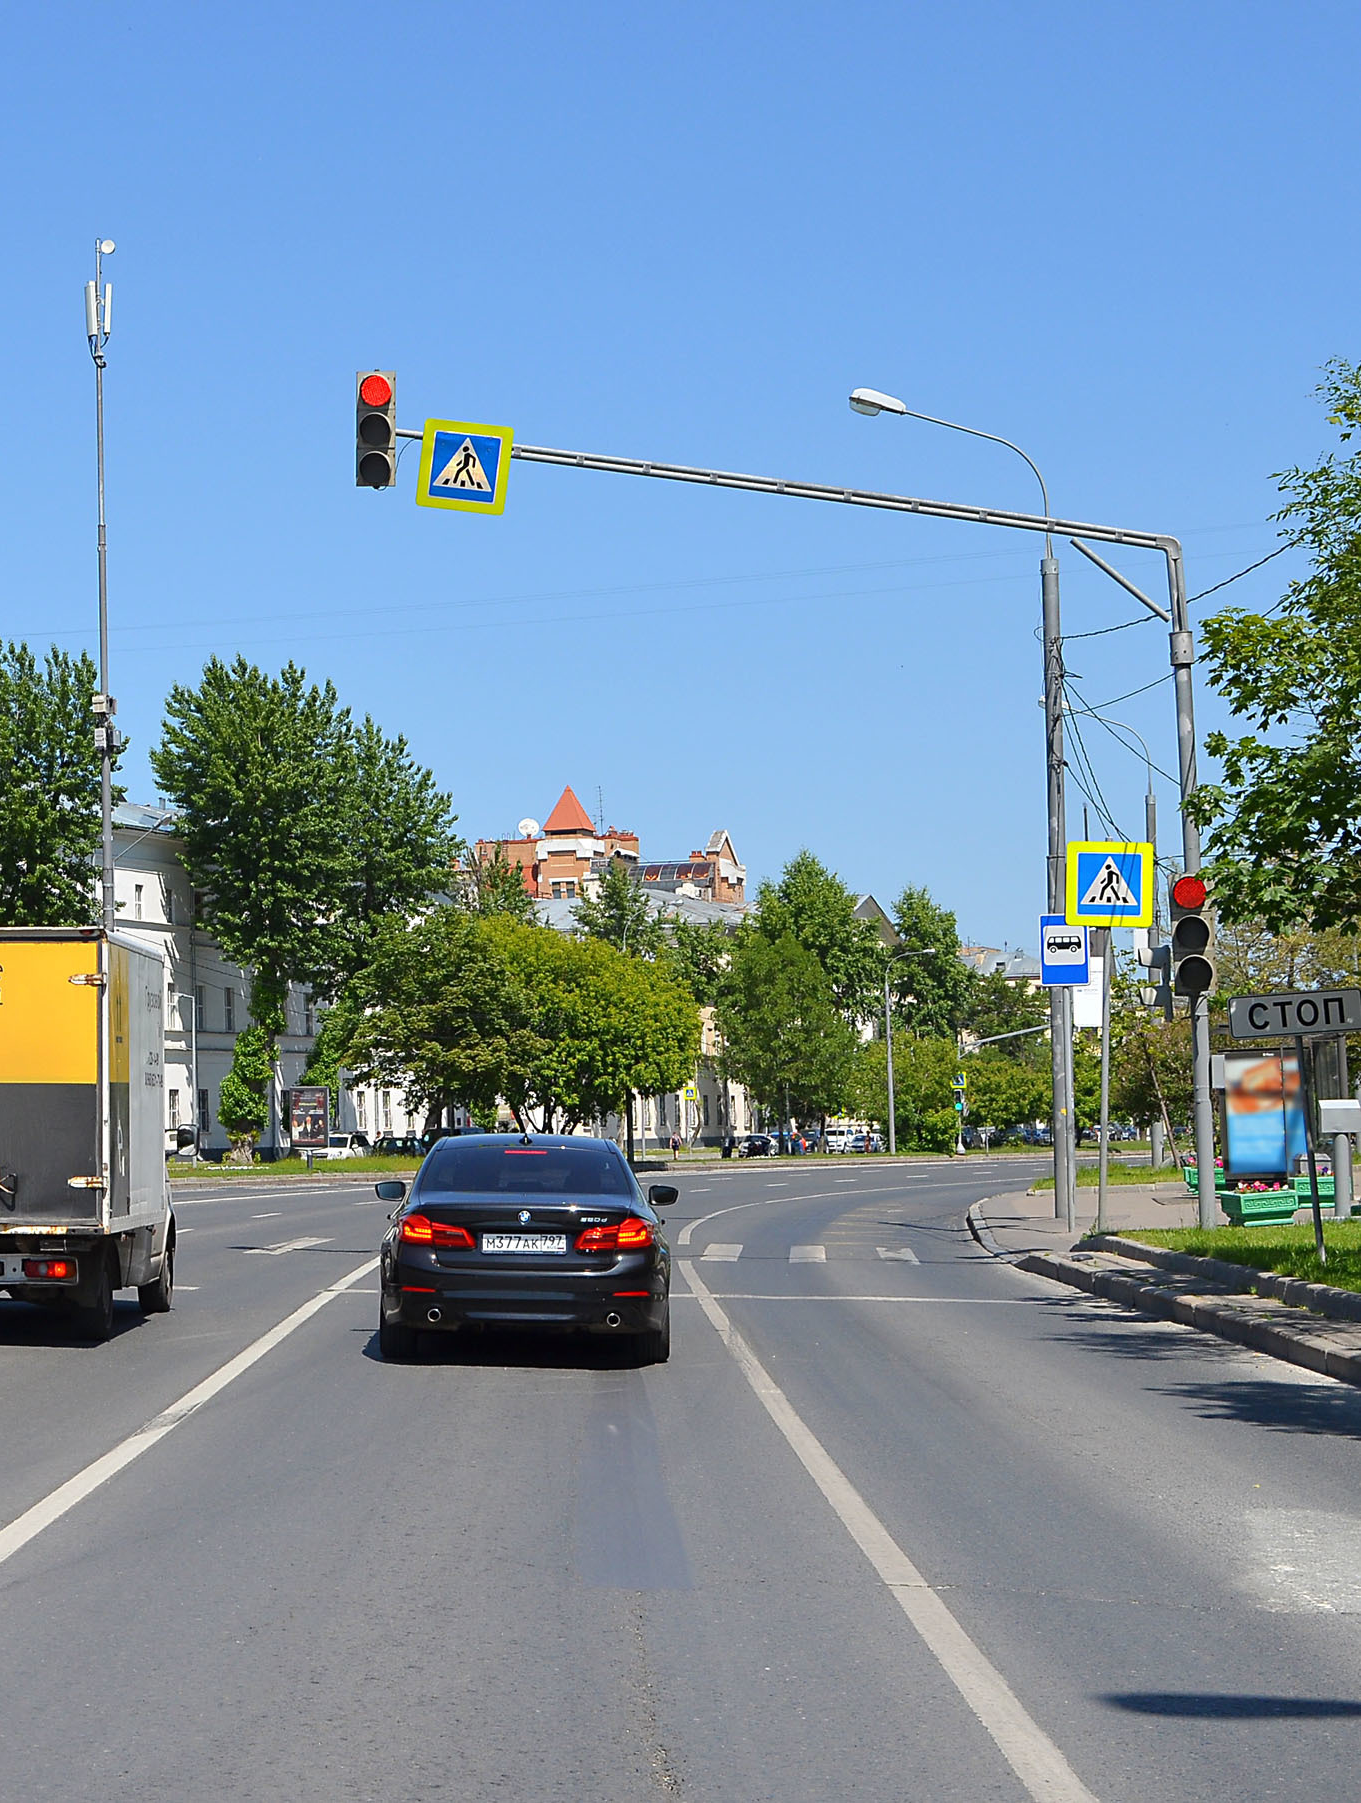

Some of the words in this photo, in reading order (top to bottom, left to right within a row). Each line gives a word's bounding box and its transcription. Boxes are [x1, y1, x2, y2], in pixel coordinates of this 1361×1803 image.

[1248, 997, 1345, 1030] СТОП
[486, 1235, 539, 1249] М377АК
[541, 1235, 563, 1246] 797
